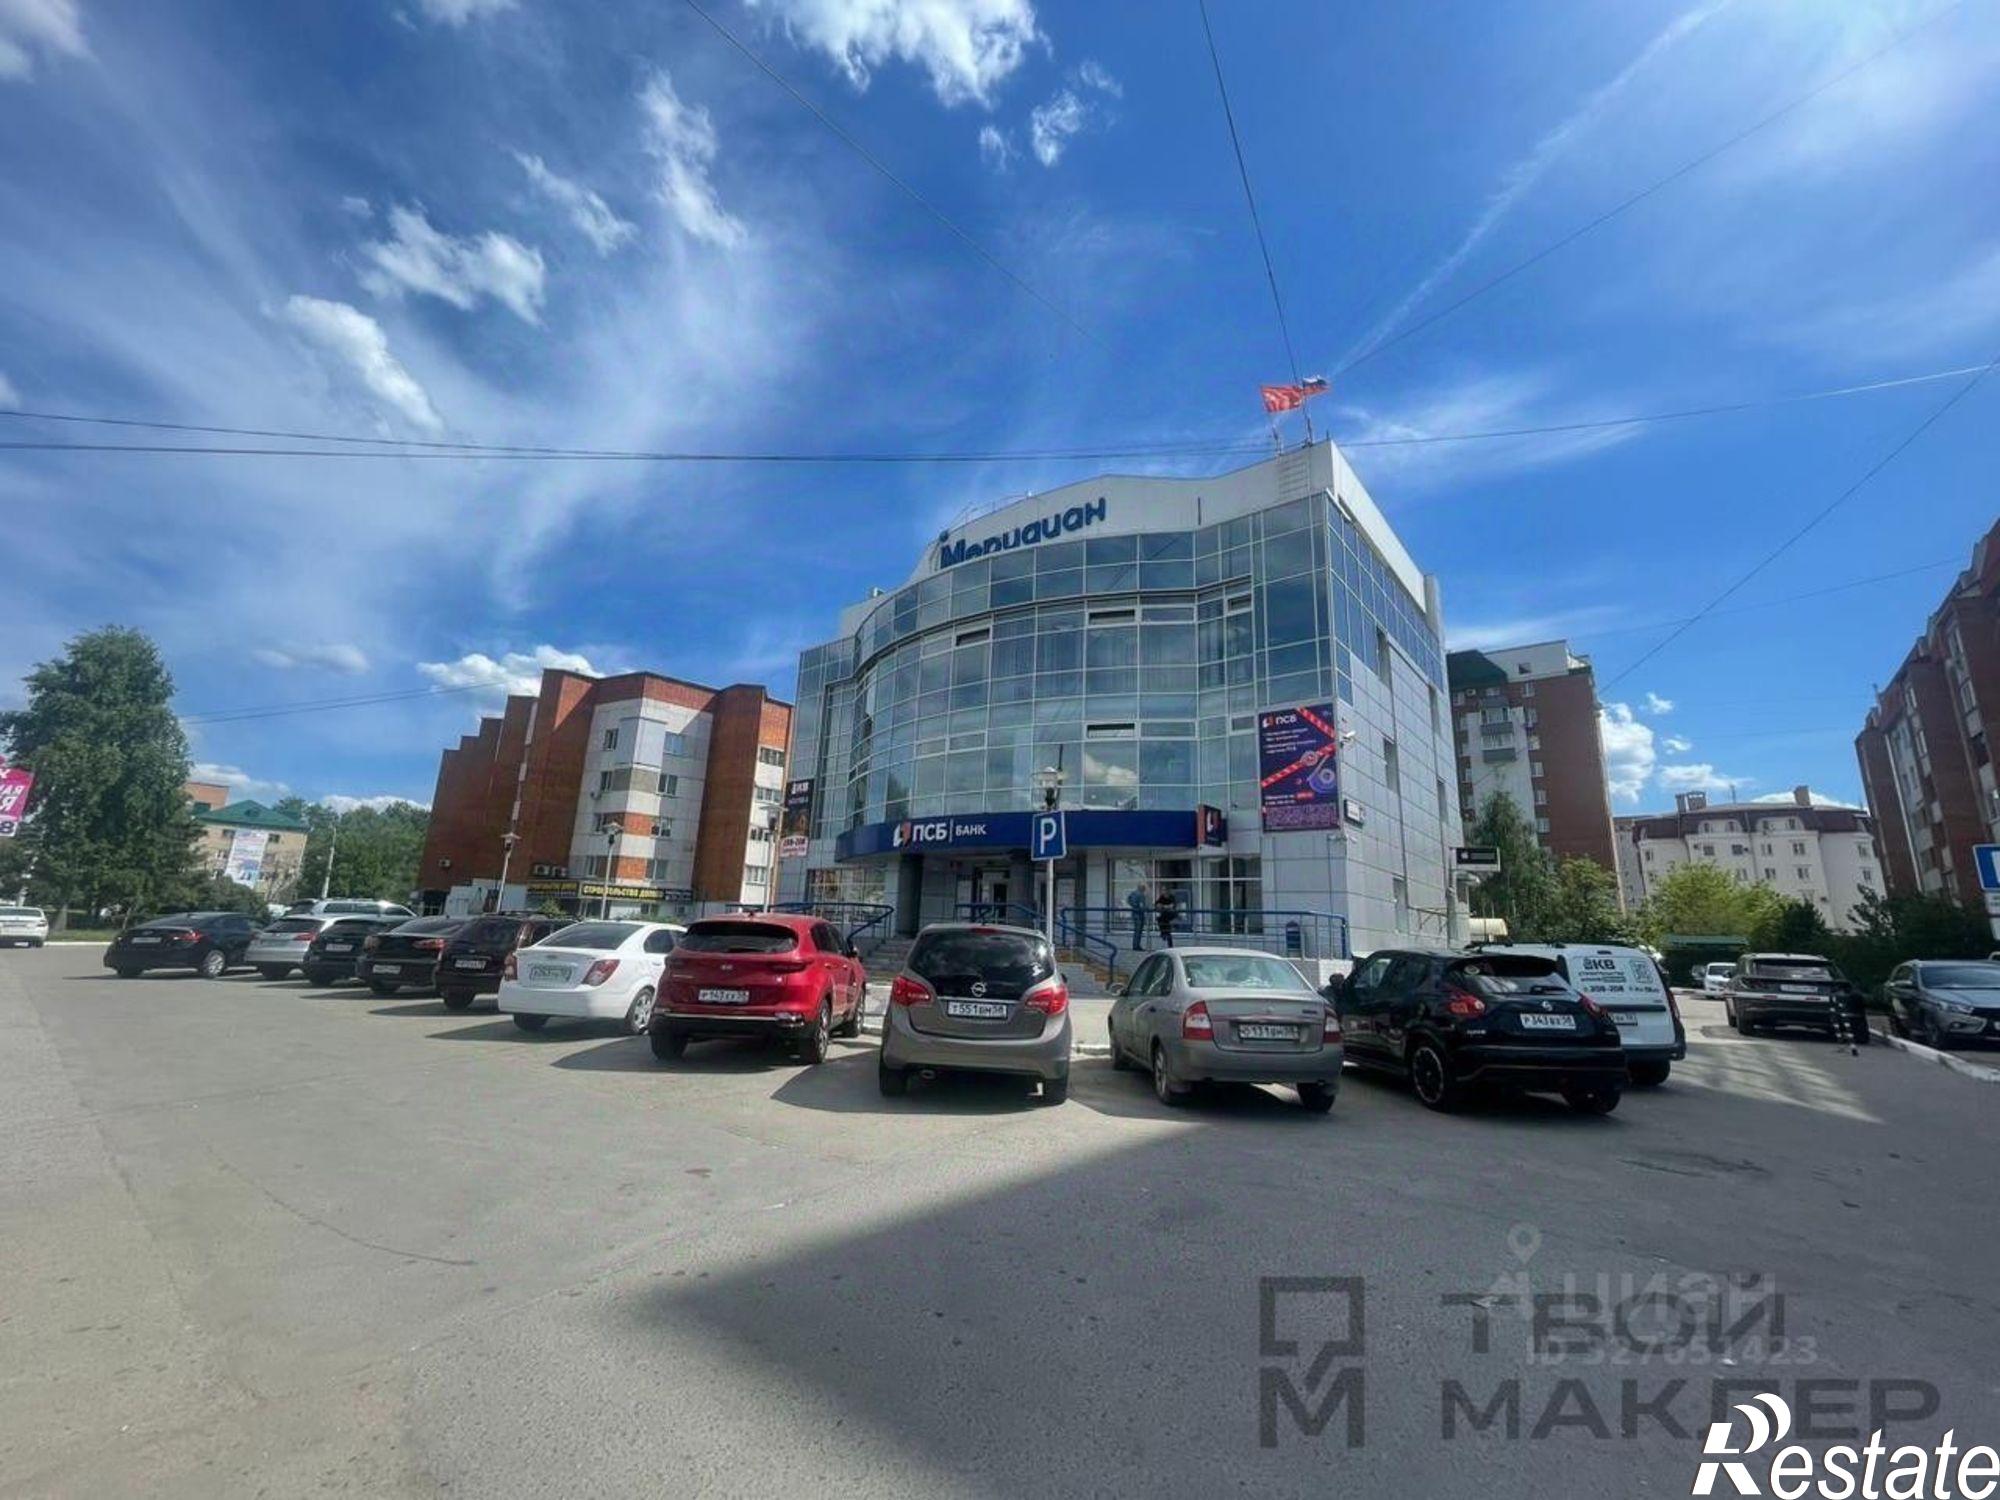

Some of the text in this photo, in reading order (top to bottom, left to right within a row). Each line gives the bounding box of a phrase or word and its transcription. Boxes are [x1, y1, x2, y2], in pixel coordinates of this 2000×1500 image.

[912, 822, 987, 842] ПСБ БАНК
[1040, 817, 1057, 854] P
